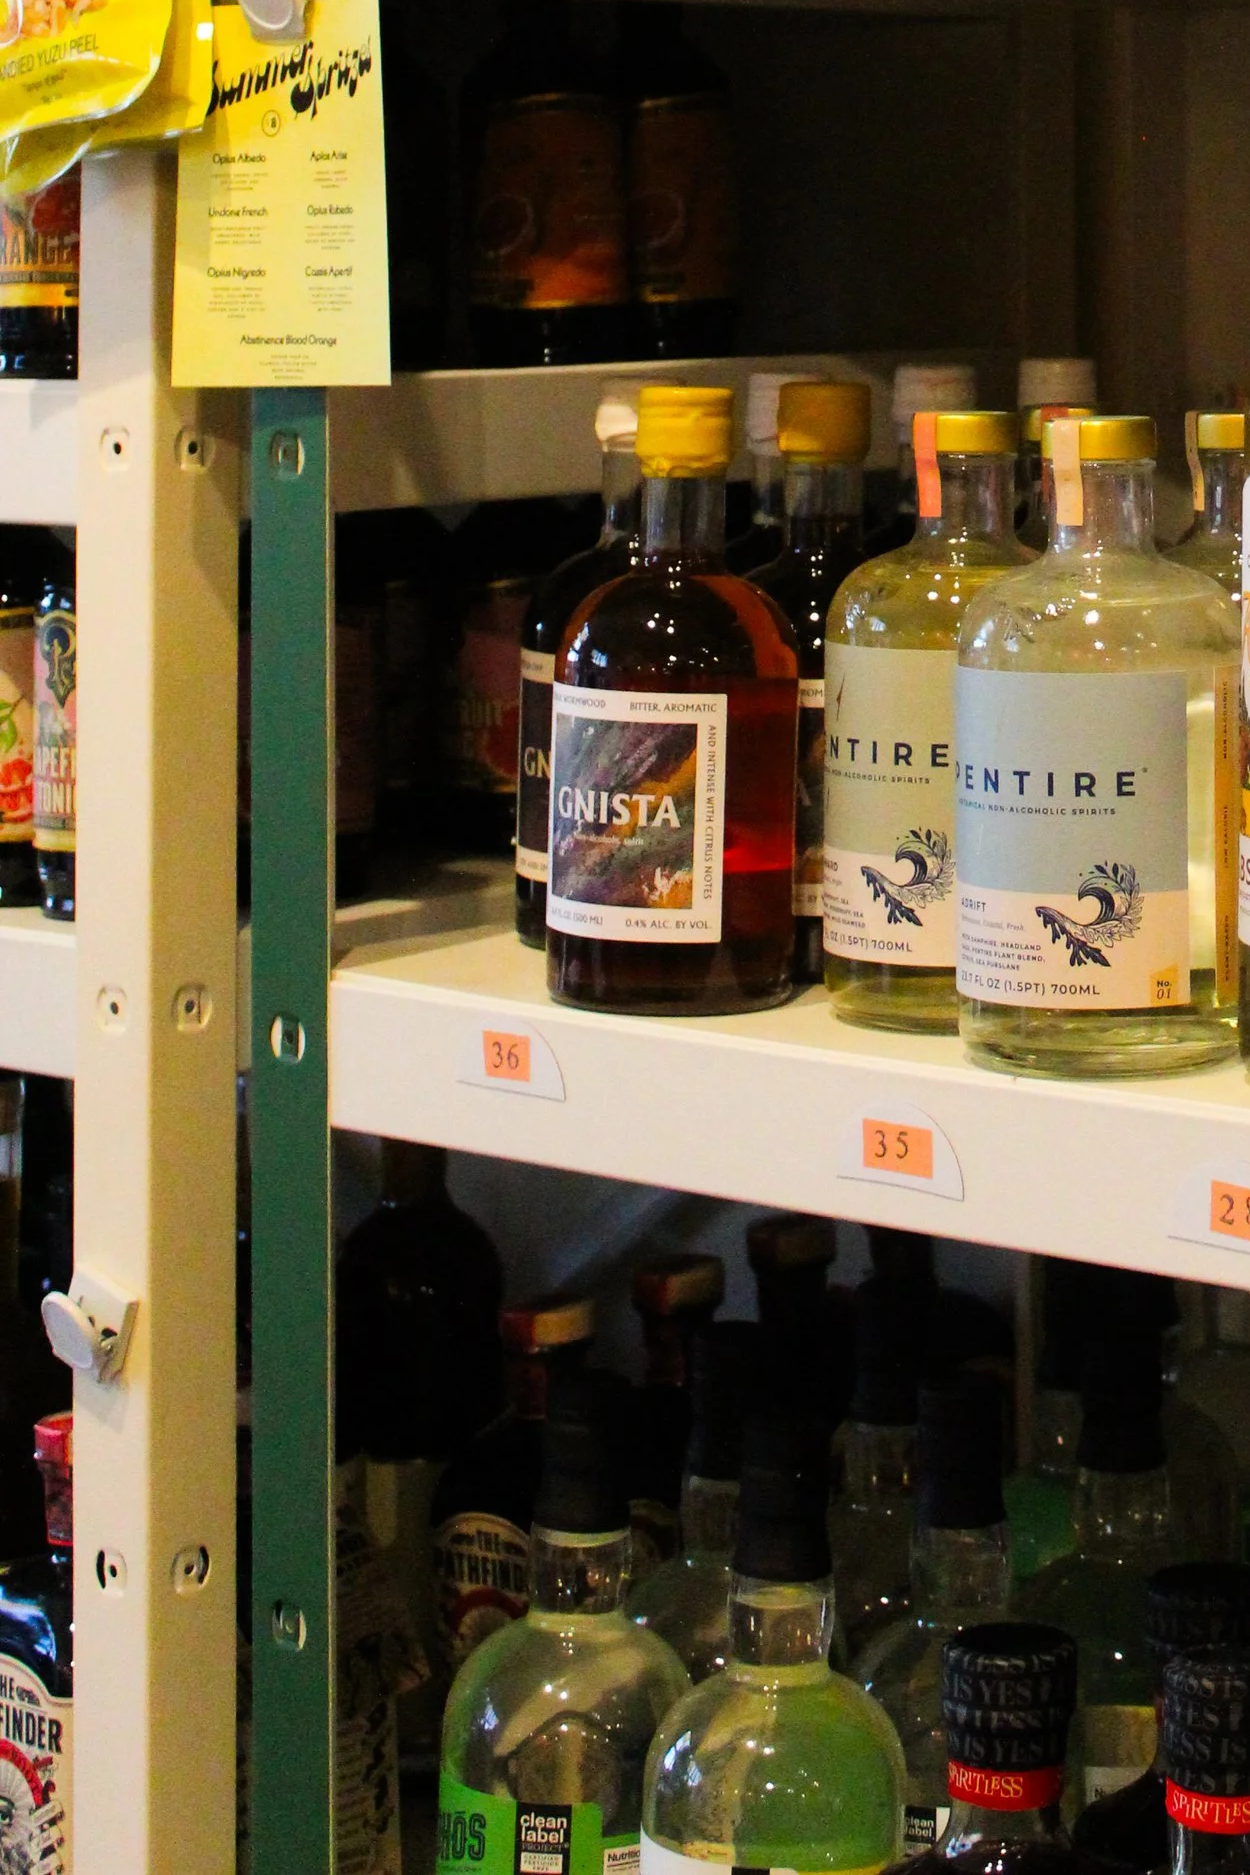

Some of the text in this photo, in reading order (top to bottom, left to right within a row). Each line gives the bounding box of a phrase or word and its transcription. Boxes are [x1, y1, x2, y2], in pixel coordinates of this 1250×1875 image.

[70, 33, 99, 54] PEEL
[206, 40, 314, 117] Summer
[208, 206, 268, 218] Undone French
[240, 335, 337, 348] Abstinence Blood Orange
[664, 702, 717, 713] AROMATIC
[891, 775, 930, 784] SPIRITS
[557, 785, 681, 829] GNISTA
[704, 725, 716, 900] AND INTENSE WITH CITRUS NOTES
[988, 804, 1117, 816] NON-ALCOHOLIC SPIRITS
[961, 897, 987, 913] ADRIFT
[625, 918, 712, 930] 0.4% ALC. BY VOL.
[871, 939, 913, 952] 700ML
[1000, 941, 1042, 952] HEADLAND
[994, 951, 1046, 963] PLANT BLEND,
[974, 974, 1100, 996] FL OZ (1.5PT) 700ML
[1156, 988, 1172, 1000] 01
[491, 1042, 520, 1071] 36
[874, 1129, 909, 1159] 35
[981, 1680, 1032, 1706] YES
[994, 1739, 1043, 1763] YES
[520, 1812, 567, 1829] clean
[521, 1826, 564, 1843] label
[521, 1843, 563, 1853] PROJECT
